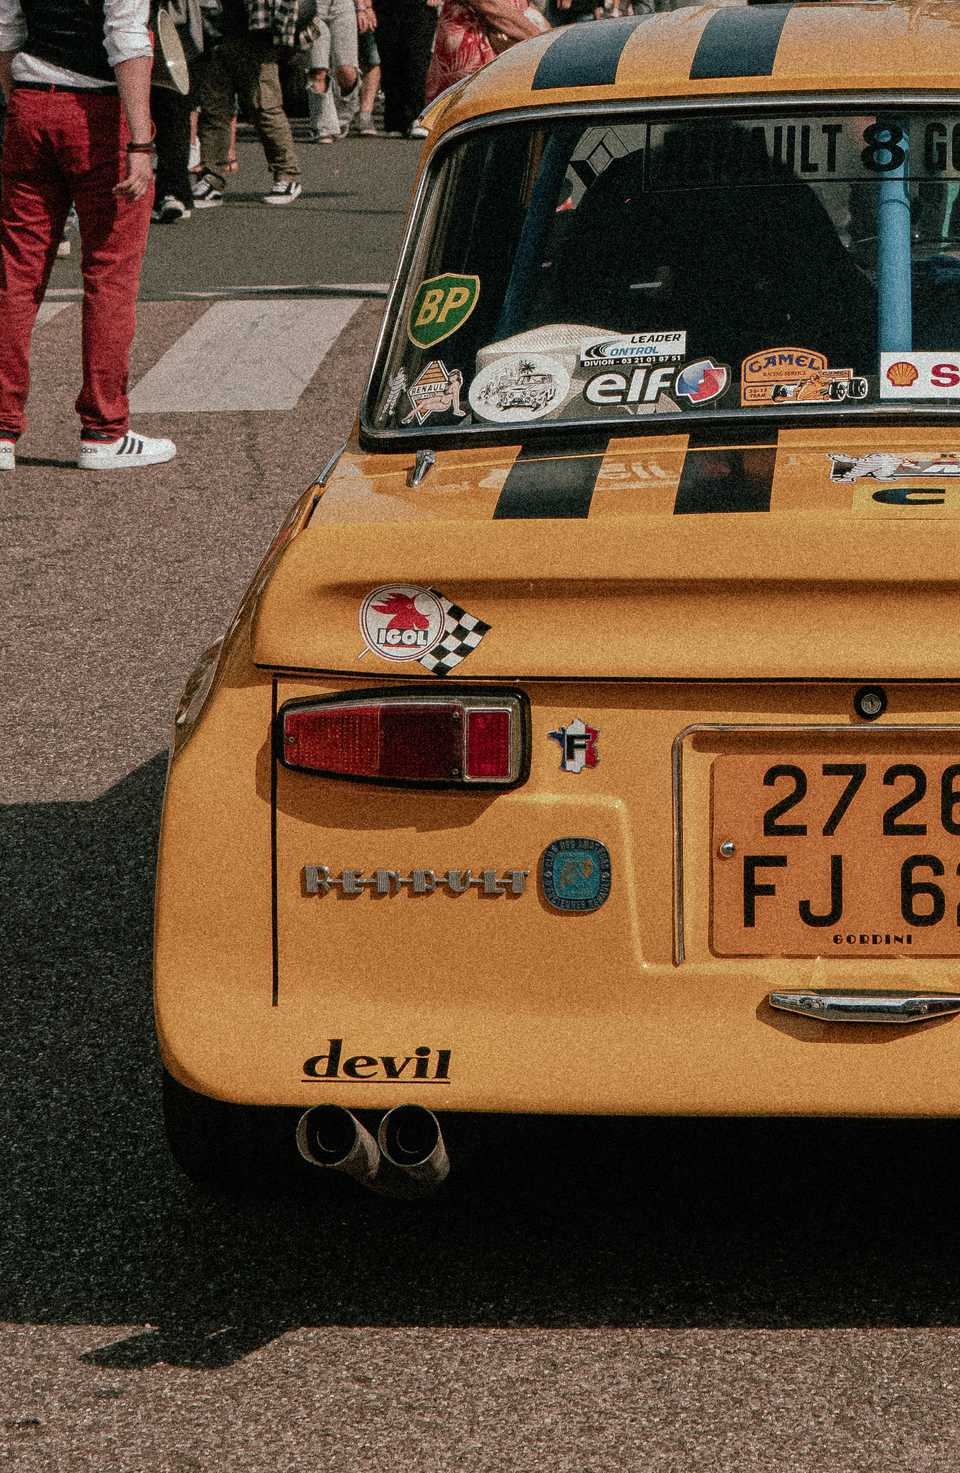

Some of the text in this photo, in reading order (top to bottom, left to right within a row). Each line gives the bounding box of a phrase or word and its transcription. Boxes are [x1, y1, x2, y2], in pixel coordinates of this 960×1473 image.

[861, 121, 907, 172] 8
[415, 286, 470, 327] BP
[630, 333, 682, 344] LEADER
[584, 359, 615, 368] DIVION
[621, 357, 632, 365] 03
[634, 356, 644, 364] 21
[748, 354, 820, 373] CAMEL
[586, 367, 675, 404] elf
[378, 628, 428, 645] IGOL
[566, 734, 591, 760] F
[743, 854, 844, 928] FJ
[832, 934, 913, 945] GORDINI
[303, 1038, 451, 1079] devil
